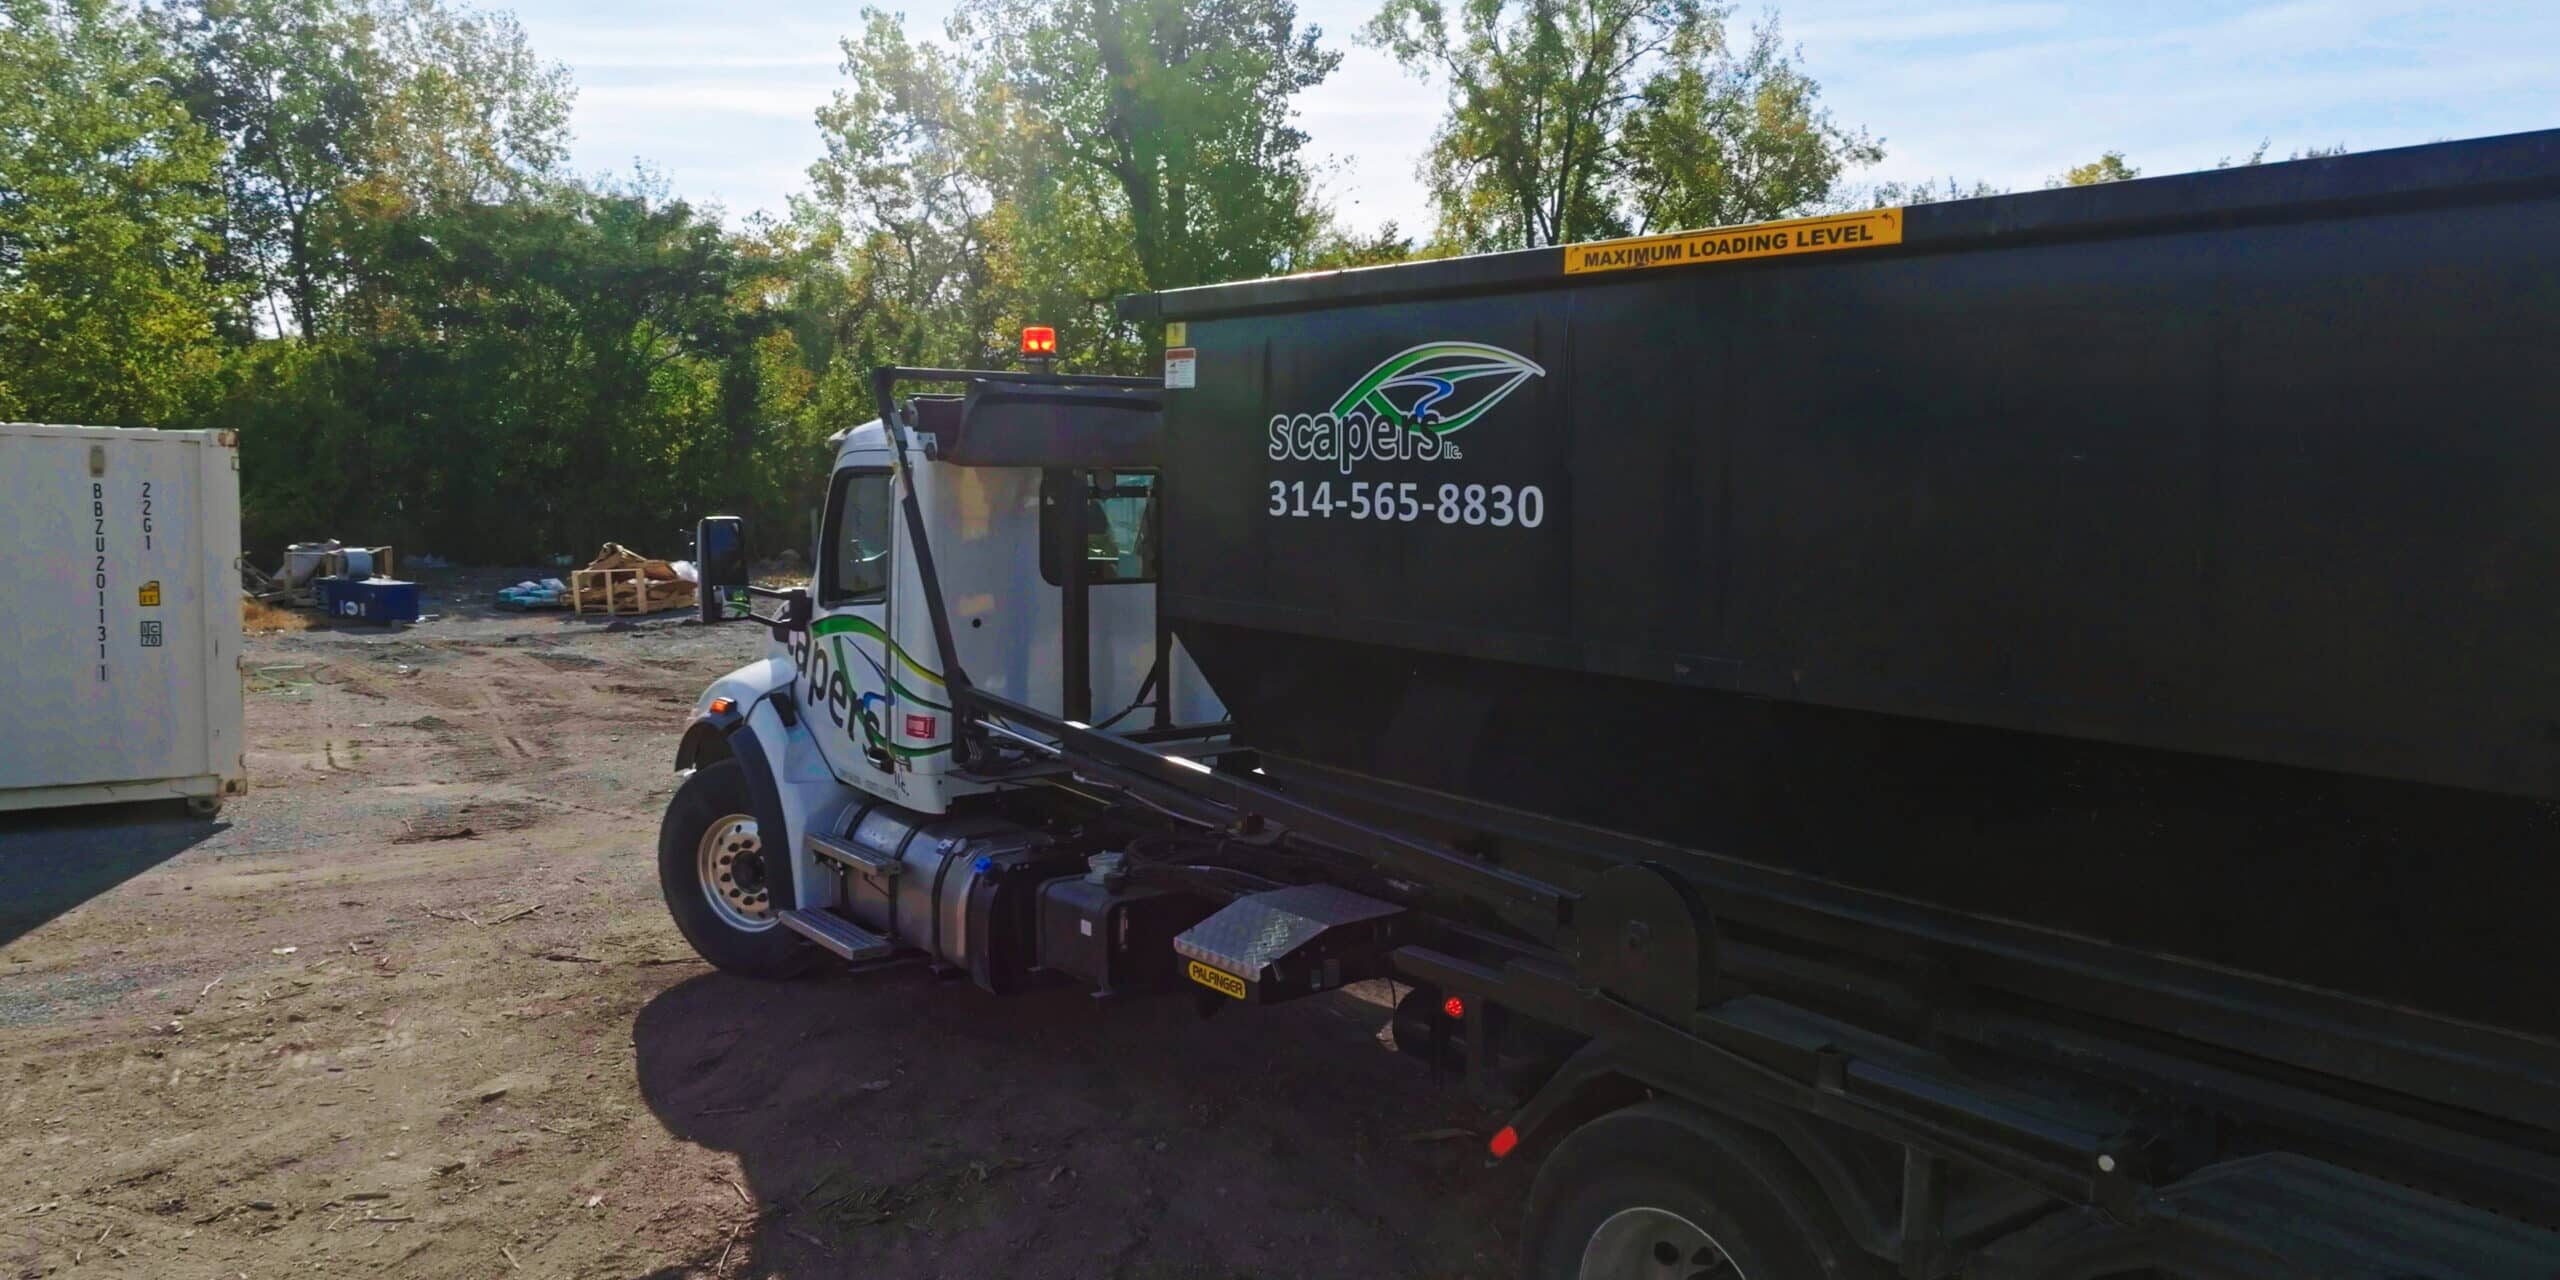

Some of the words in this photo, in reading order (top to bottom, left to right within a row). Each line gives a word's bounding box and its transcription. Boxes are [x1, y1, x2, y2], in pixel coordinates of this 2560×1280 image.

[1584, 242, 1682, 268] MAXIMUM
[1689, 232, 1788, 258] LOADING
[1796, 224, 1873, 248] LEVEL
[1269, 411, 1443, 474] scapers
[142, 482, 152, 550] 22G1
[1269, 480, 1544, 528] 314-565-8830
[1192, 964, 1243, 996] PALFINGER
